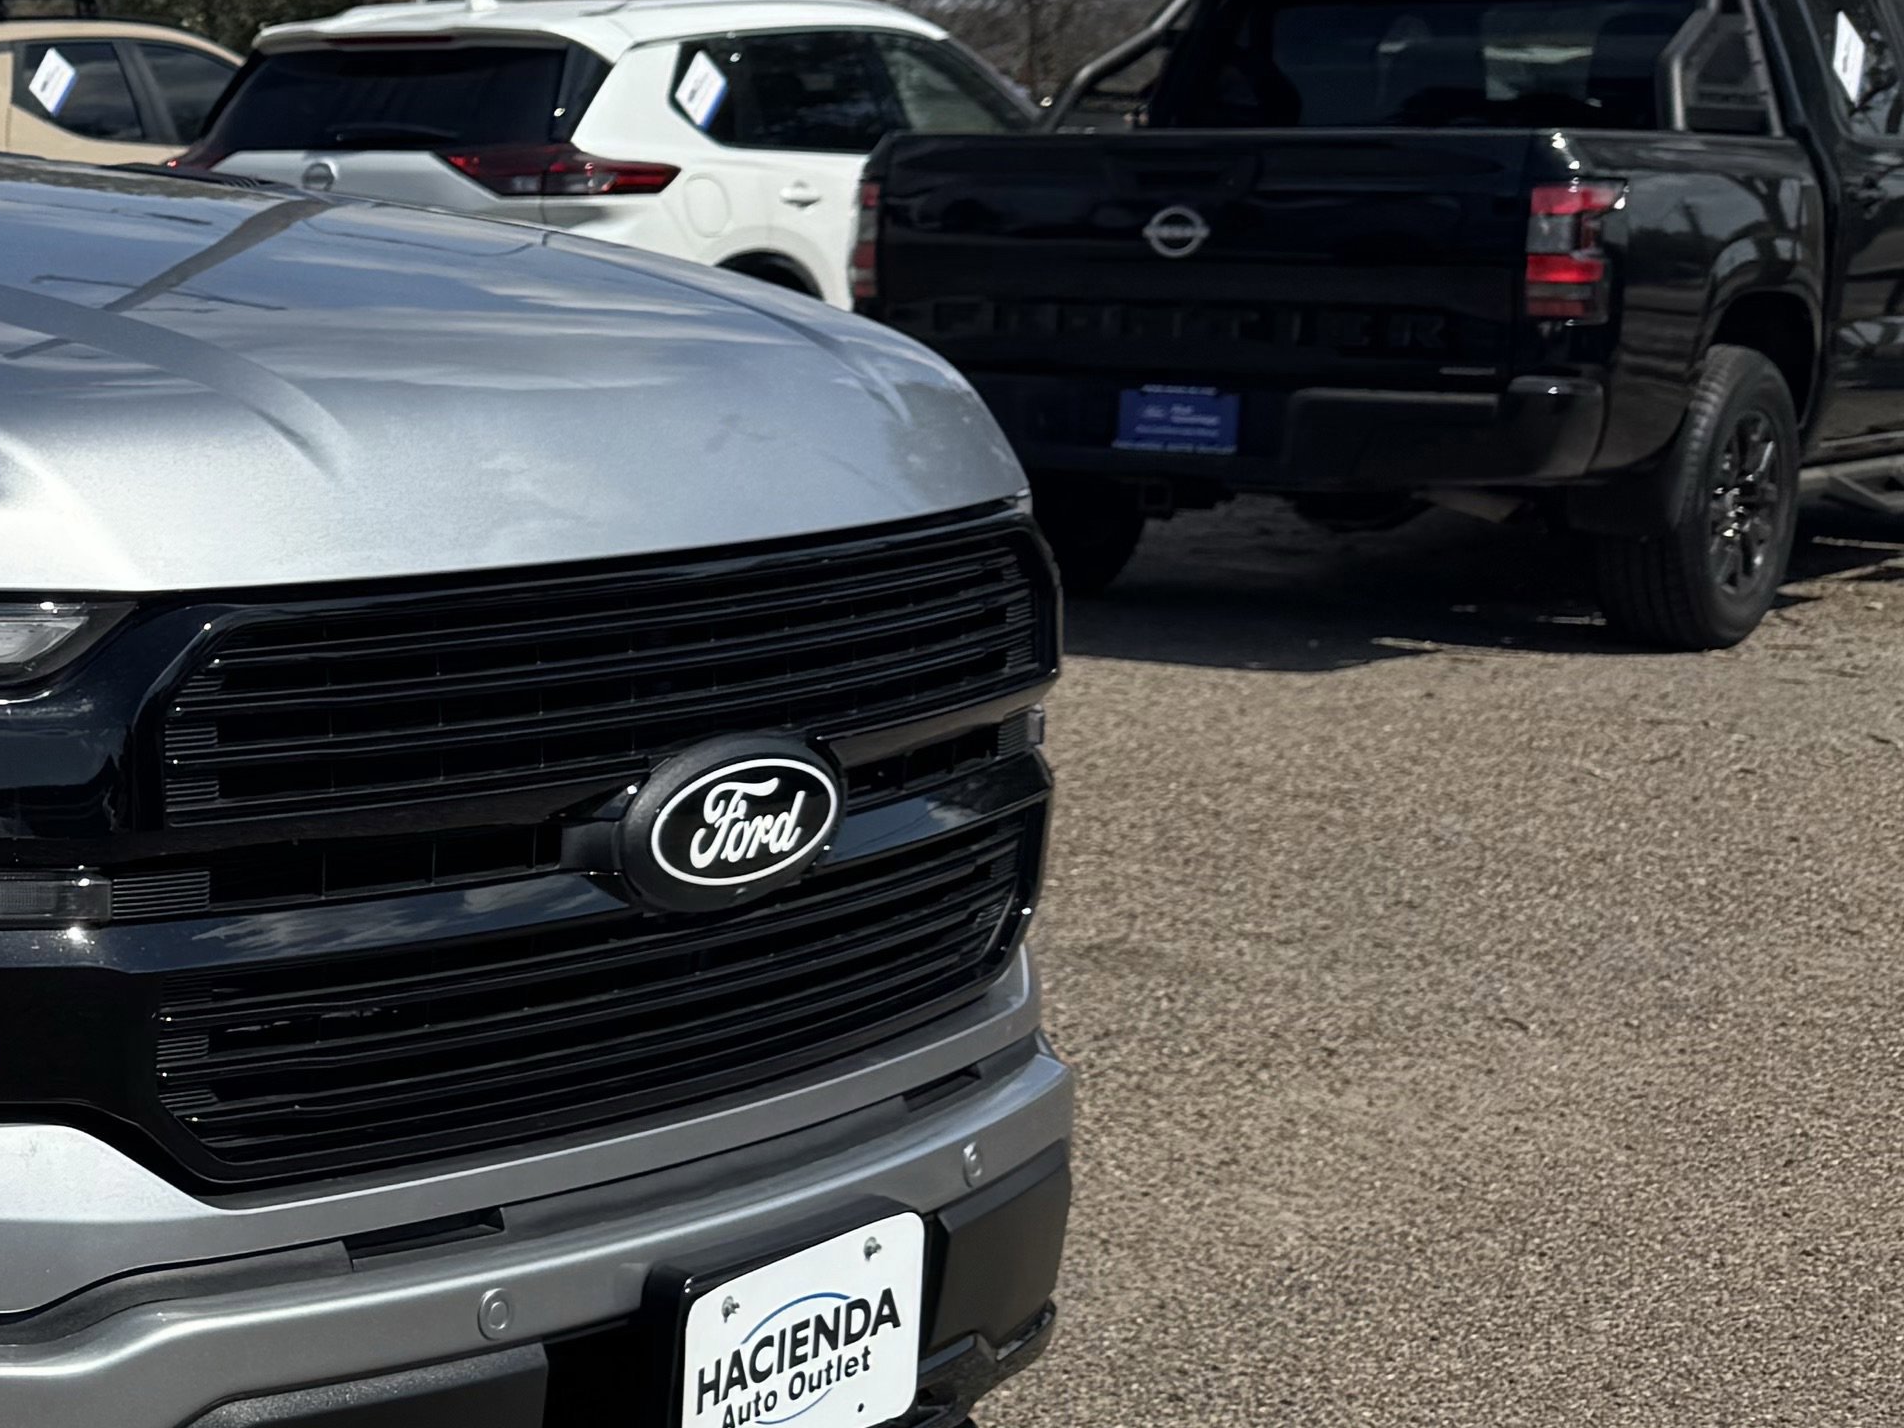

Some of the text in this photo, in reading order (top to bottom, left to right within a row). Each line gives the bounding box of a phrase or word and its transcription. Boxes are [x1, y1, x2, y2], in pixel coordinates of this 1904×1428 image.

[690, 777, 806, 869] Ford
[696, 1287, 901, 1415] HACIENDA
[788, 1345, 871, 1400] Outlet
